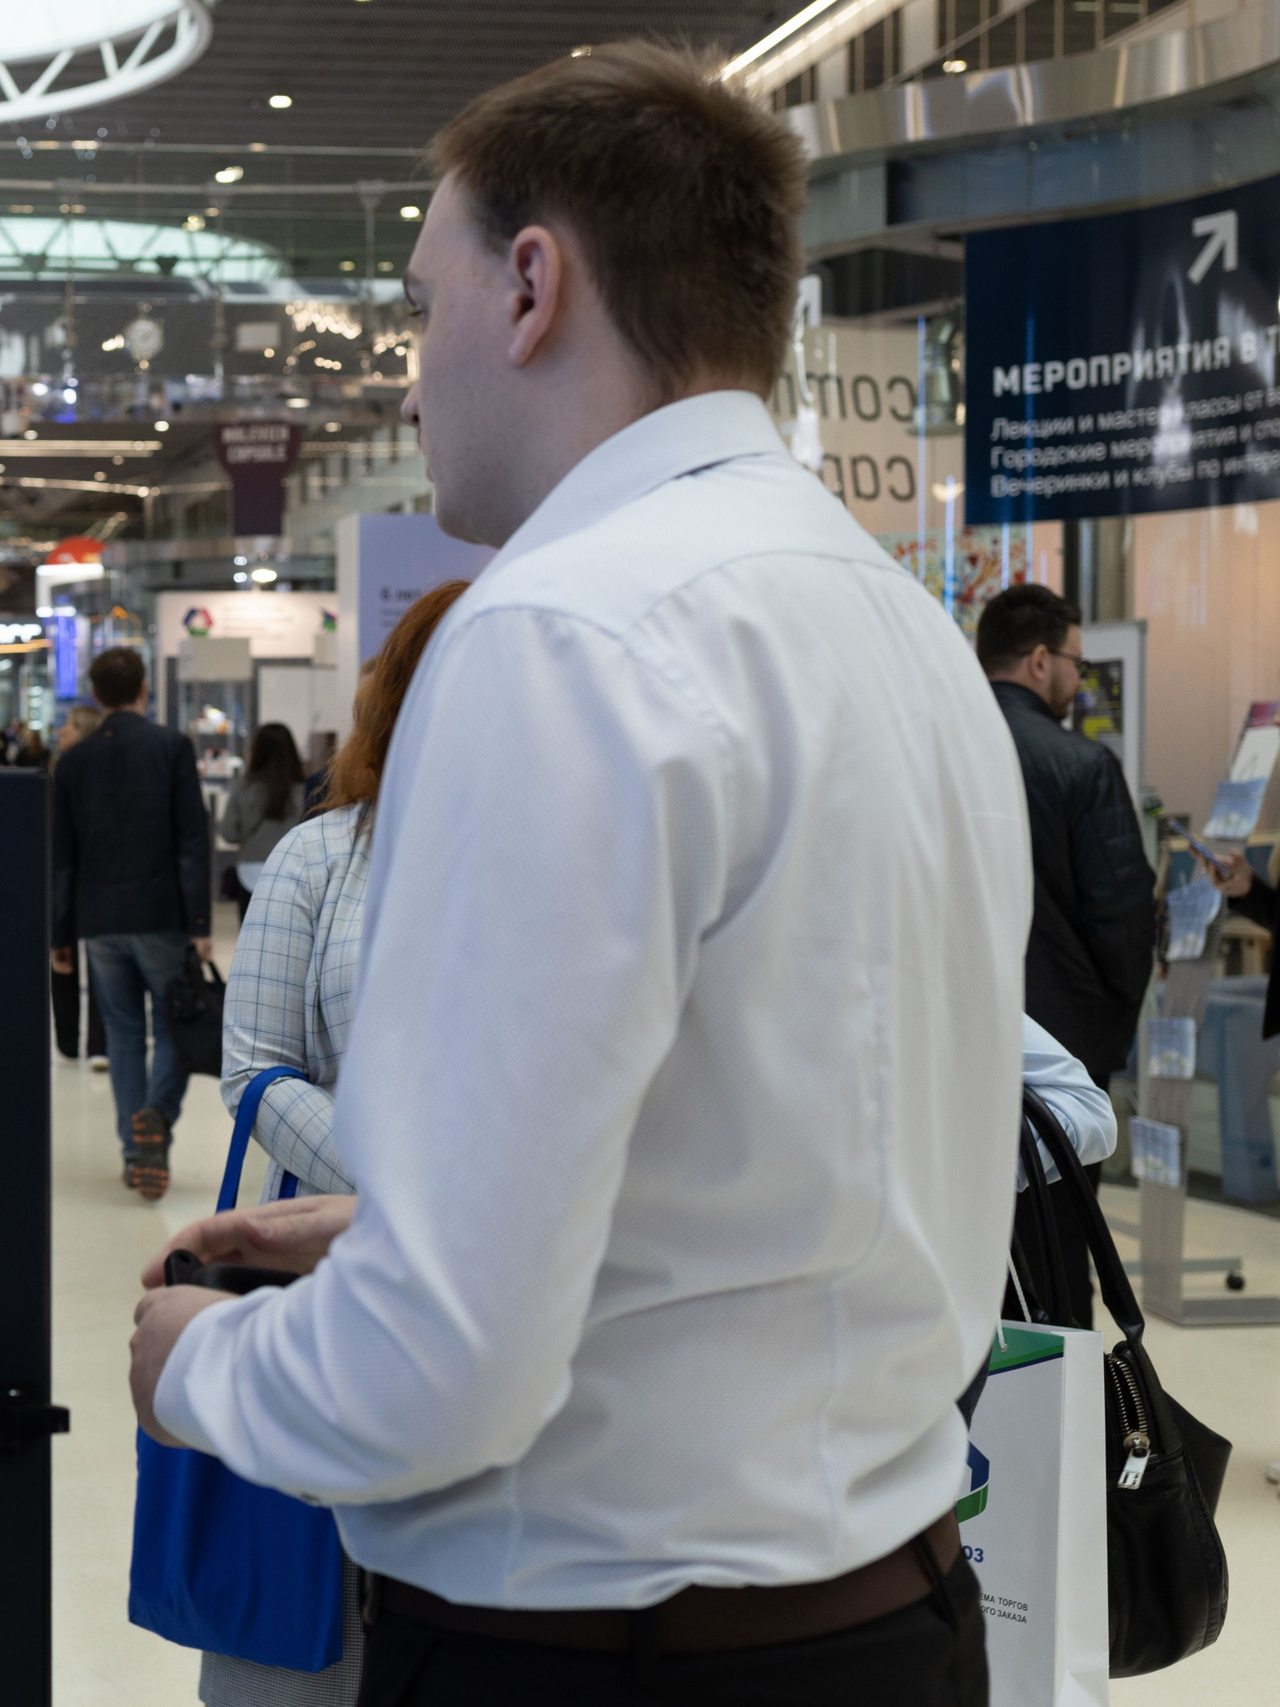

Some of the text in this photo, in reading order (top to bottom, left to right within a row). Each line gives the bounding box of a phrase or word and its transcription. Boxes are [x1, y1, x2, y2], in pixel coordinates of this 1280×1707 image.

[992, 335, 1232, 397] МЕРОПРИЯТИЯ
[990, 417, 1075, 441] Лекции
[1078, 414, 1094, 433] и
[1243, 390, 1264, 412] от
[991, 445, 1107, 472] Городские
[991, 474, 1110, 499] Вечеринки
[1113, 469, 1129, 488] и
[1132, 460, 1194, 490] клубы
[1197, 458, 1220, 480] по
[997, 1609, 1028, 1624] ЗАКАЗА
[998, 1597, 1029, 1612] ТОРГОВ
